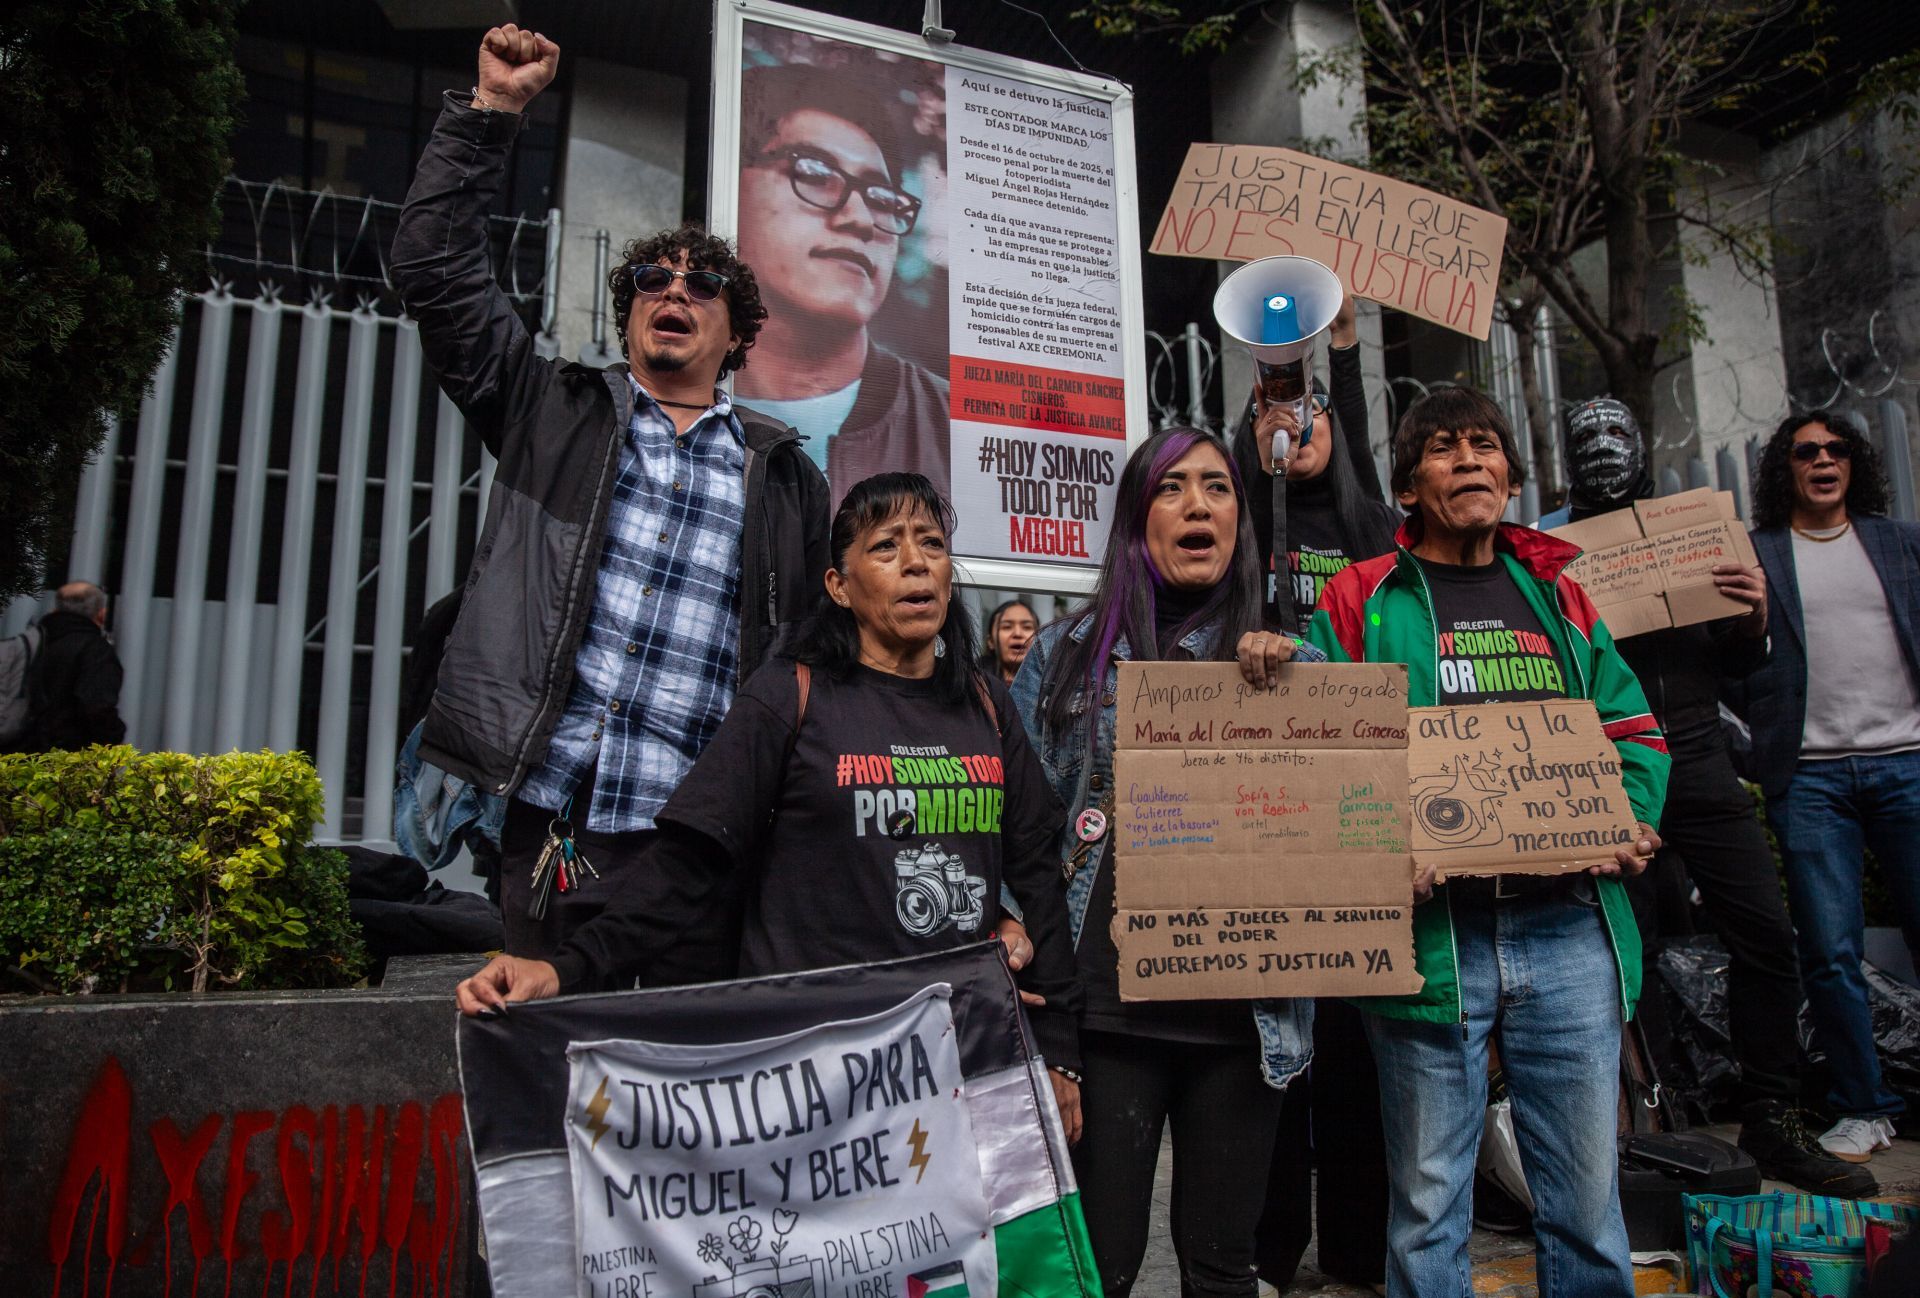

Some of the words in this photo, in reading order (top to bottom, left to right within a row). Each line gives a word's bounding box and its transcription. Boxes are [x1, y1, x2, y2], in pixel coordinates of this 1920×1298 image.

[961, 78, 990, 92] Aquí
[994, 87, 1006, 95] se
[1009, 89, 1049, 105] detuvo
[1052, 98, 1062, 108] la
[1066, 101, 1108, 119] justicia.
[964, 102, 988, 114] ESTE
[990, 108, 1048, 127] CONTADOR
[1050, 121, 1087, 136] MARCA
[1090, 130, 1107, 141] LOS
[985, 118, 1010, 130] DÍAS
[1012, 124, 1026, 134] DE
[964, 150, 1001, 162] proceso
[1003, 158, 1030, 169] penal
[1032, 164, 1048, 172] por
[1051, 166, 1059, 175] la
[1061, 170, 1094, 183] muerte
[1096, 177, 1110, 186] del
[1005, 168, 1071, 189] fotoperiodista
[965, 172, 999, 186] Miguel
[1002, 178, 1030, 192] Ángel
[1033, 186, 1057, 198] Rojas
[1060, 191, 1109, 209] Hernández
[991, 191, 1043, 206] permanece
[1045, 200, 1088, 216] detenido.
[1196, 145, 1386, 215] JUSTICIA
[1408, 198, 1478, 243] QUE
[964, 208, 988, 219] Cada
[990, 213, 1006, 223] día
[1008, 218, 1026, 226] que
[1028, 222, 1062, 234] avanza
[1184, 181, 1299, 222] TARDA
[1316, 200, 1360, 239] EN
[1377, 219, 1490, 283] LLEGAR
[988, 237, 1002, 246] las
[1004, 242, 1048, 255] empresas
[1050, 250, 1108, 266] responsables
[1155, 207, 1216, 254] NO
[1224, 210, 1294, 261] ES
[1321, 232, 1477, 332] JUSTICIA
[965, 282, 985, 293] Esta
[988, 286, 1028, 301] decisión
[1031, 294, 1042, 302] de
[1044, 296, 1054, 304] la
[1056, 299, 1080, 310] jueza
[962, 295, 996, 307] impide
[999, 302, 1017, 310] que
[1032, 306, 1076, 320] formulen
[1078, 315, 1108, 325] cargos
[1109, 318, 1120, 328] de
[971, 309, 1020, 323] homicidio
[1022, 318, 1053, 329] contra
[1056, 322, 1069, 331] las
[1071, 326, 1113, 339] empresas
[978, 335, 1015, 348] festival
[1018, 342, 1040, 352] AXE
[1042, 345, 1106, 362] CEREMONIA.
[964, 366, 992, 381] JUEZA
[995, 370, 1024, 387] MARÍA
[1028, 375, 1043, 389] DEL
[1047, 376, 1082, 394] CARMEN
[1086, 379, 1124, 399] SÁNCHEZ
[1022, 390, 1068, 408] CISNEROS:
[964, 398, 1005, 416] PERMITA
[1010, 403, 1026, 419] QUE
[1030, 407, 1041, 421] LA
[1044, 408, 1085, 426] JUSTICIA
[1088, 414, 1125, 432] AVANCE.
[978, 437, 1036, 477] #HOY
[1042, 444, 1114, 485] SOMOS
[997, 477, 1050, 516] TODO
[1056, 483, 1098, 521] POR
[1010, 516, 1089, 558] MIGUEL
[1454, 620, 1505, 630] COLECTIVA
[1134, 670, 1224, 713] Amparos
[1308, 675, 1398, 707] otorgado
[1136, 720, 1181, 743] María
[1188, 720, 1213, 742] del
[1221, 722, 1272, 742] Carmen
[1282, 718, 1342, 742] Sanchez
[1353, 719, 1407, 741] Cisneros
[1419, 709, 1481, 740] arte
[1506, 715, 1531, 752] y
[1540, 704, 1576, 735] la
[891, 745, 949, 756] COLECTIVA
[1181, 751, 1209, 768] Jueza
[1214, 752, 1226, 765] de
[1508, 752, 1618, 797] fotografía
[1236, 785, 1269, 804] Sofía
[1277, 786, 1289, 799] S.
[1342, 782, 1373, 800] Uriel
[854, 788, 1004, 837] PORMIGUE
[1235, 808, 1254, 816] von
[1339, 800, 1392, 815] Carmona
[1522, 800, 1555, 818] no
[1568, 797, 1613, 818] son
[1152, 822, 1165, 832] de
[1508, 825, 1635, 853] mercancía
[1128, 914, 1156, 932] NO
[1224, 911, 1289, 927] JUECES
[1304, 909, 1326, 922] AL
[1333, 909, 1401, 922] SERVICIO
[1173, 933, 1204, 947] DEL
[1218, 929, 1278, 943] PODER
[1136, 953, 1247, 978] QUEREMOS
[1258, 951, 1355, 973] JUSTICIA
[1363, 949, 1393, 974] YA
[616, 1057, 832, 1151] JUSTICIA
[842, 1033, 938, 1118] PARA
[603, 1167, 757, 1221] MIGUEL
[769, 1157, 793, 1202] Y
[808, 1129, 900, 1202] BERE
[824, 1211, 951, 1280] PALESTINA
[582, 1246, 658, 1276] PALESTINA
